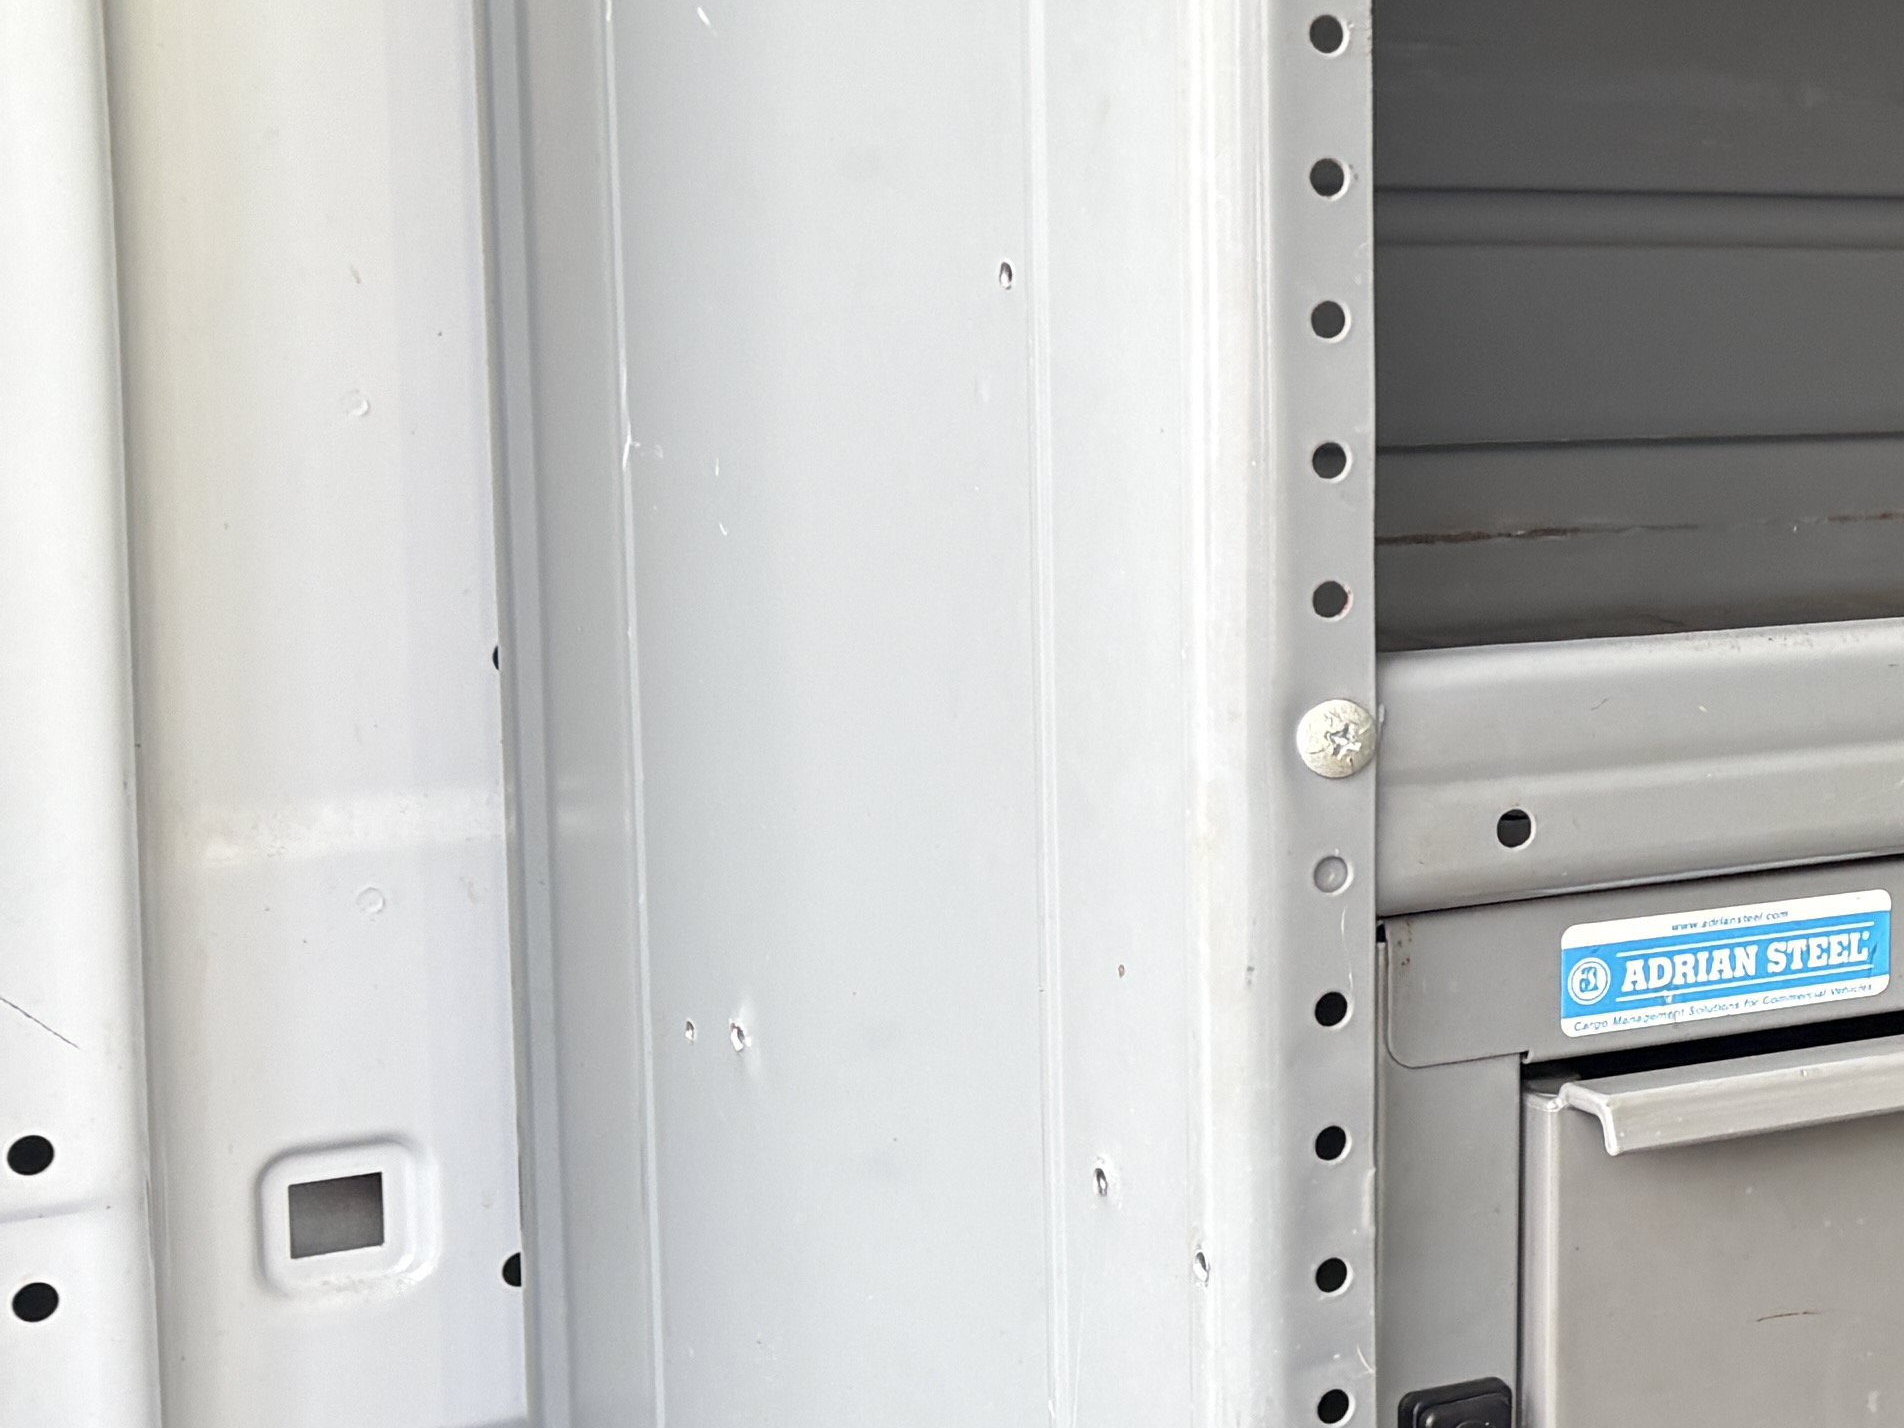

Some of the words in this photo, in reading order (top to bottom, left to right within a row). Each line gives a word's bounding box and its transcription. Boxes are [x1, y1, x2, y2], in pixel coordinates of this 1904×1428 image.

[1621, 944, 1758, 992] ADRIAN
[1767, 932, 1869, 973] STEEL
[1574, 1020, 1608, 1032] Cargo
[1613, 1008, 1685, 1025] Management
[1689, 1002, 1739, 1016] Solutions
[1744, 998, 1759, 1008] for
[1763, 988, 1826, 1005] Commercial
